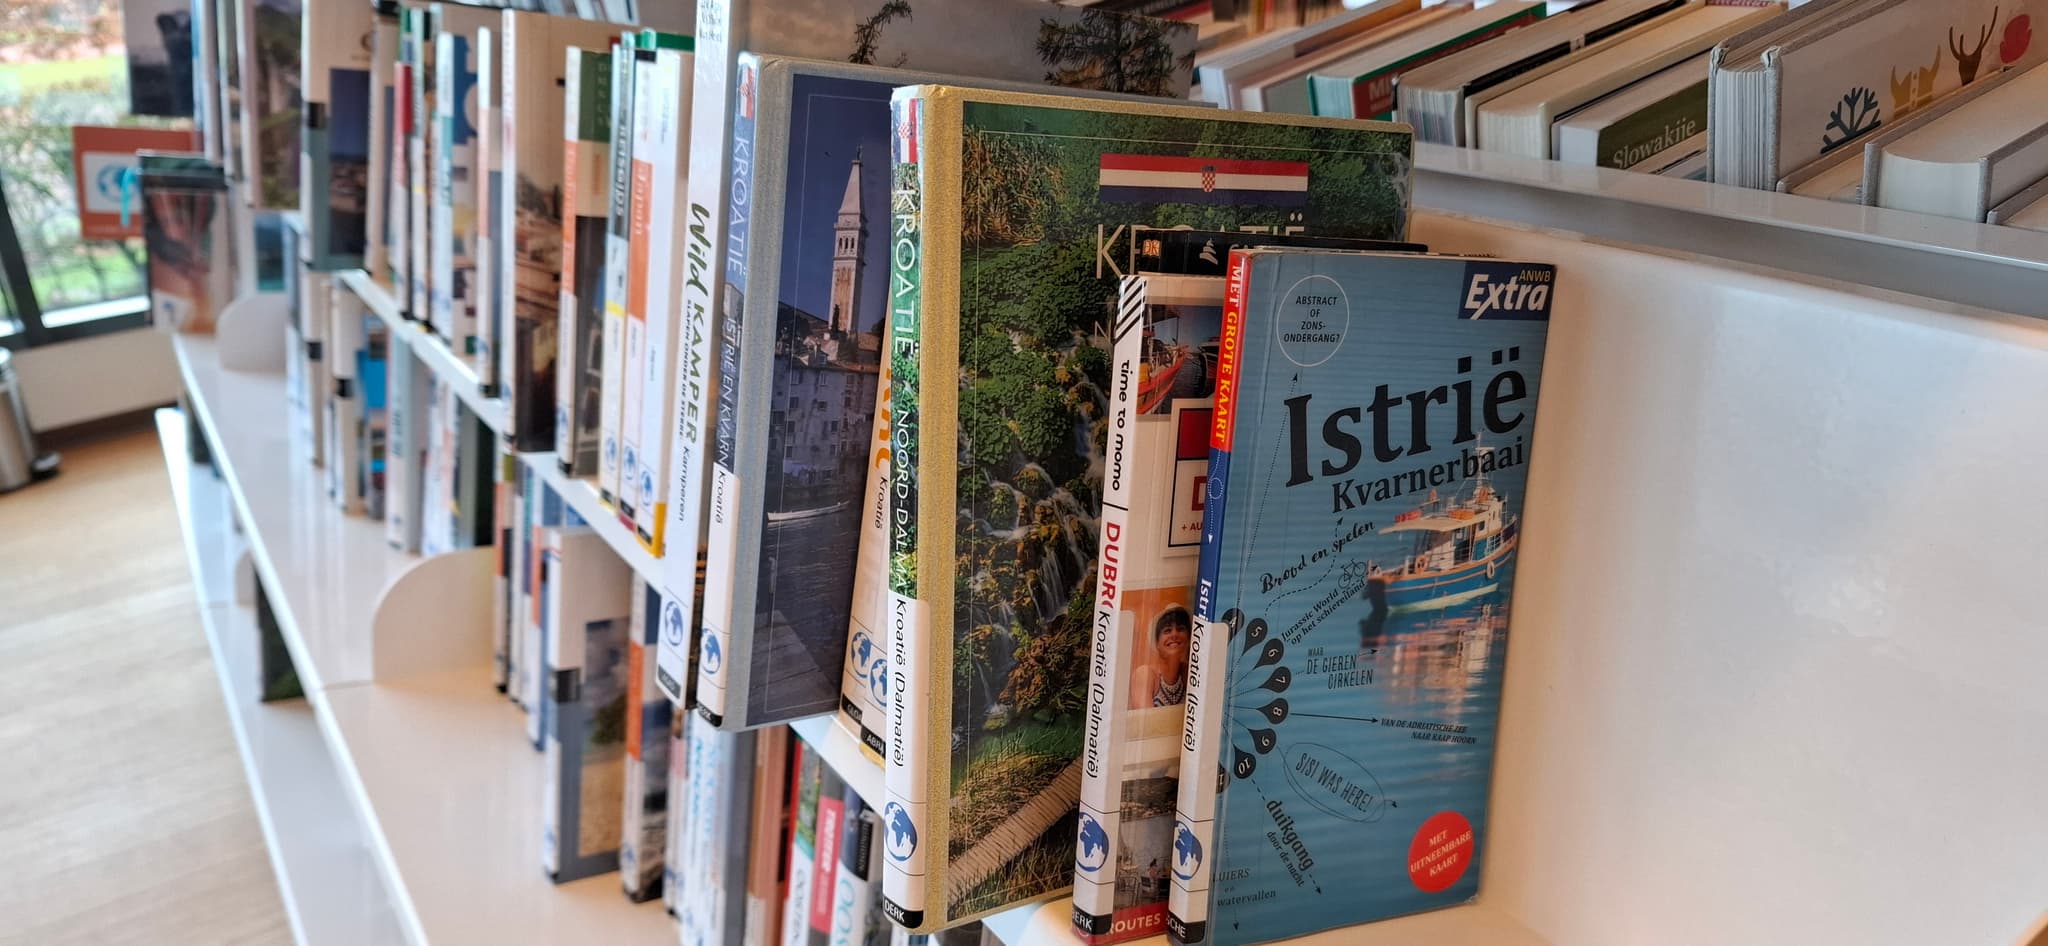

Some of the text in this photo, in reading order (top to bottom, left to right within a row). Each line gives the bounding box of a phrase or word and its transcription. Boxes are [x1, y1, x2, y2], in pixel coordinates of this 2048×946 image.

[728, 137, 750, 277] KROATIË
[894, 190, 919, 354] KROATIË
[1229, 265, 1242, 308] MET
[1519, 269, 1551, 282] ANWB
[1296, 295, 1337, 305] ABSTRACT
[1310, 308, 1320, 318] OF
[1464, 273, 1549, 320] Extra
[687, 203, 712, 444] Wild KAMPER
[722, 318, 737, 373] ISTRIË
[1222, 311, 1238, 375] GROTE
[1283, 333, 1340, 343] ONDERGANG?
[1301, 321, 1326, 330] ZONS-
[721, 375, 734, 401] EN
[1215, 378, 1232, 443] KAART
[1112, 359, 1133, 492] time to momo
[1284, 346, 1527, 488] Istrië
[679, 446, 691, 522] Kamperen
[715, 470, 726, 524] Kroatië
[1332, 436, 1524, 514] Kvarnerbaai
[875, 476, 889, 530] Kroatië
[1101, 521, 1120, 609] DUBR
[1260, 521, 1376, 595] Brood en spelen
[1251, 626, 1262, 637] 5
[1281, 588, 1339, 640] Jurassic World
[1290, 579, 1365, 645] op het schiereiland
[1268, 648, 1279, 657] 6
[1306, 654, 1357, 674] DE GIEREN
[1308, 647, 1324, 656] WAAR
[892, 598, 907, 768] Kroatië (Dalmatië)
[1086, 610, 1110, 779] Kroatië (Dalmatië)
[1184, 621, 1204, 752] Kroatië (Istrië)
[1275, 676, 1286, 684] 7
[1328, 668, 1373, 690] CIRKELEN
[1273, 706, 1282, 716] 8
[1381, 717, 1468, 734] VAN DE ADRIATISCHE ZEE
[1261, 735, 1270, 747] 9
[1411, 731, 1478, 745] NAAR KAAP HOORN
[1238, 757, 1251, 775] 10
[1296, 752, 1374, 813] SISI WAS HERE!
[1266, 800, 1314, 872] duikgang
[1410, 830, 1471, 873] UITNEEMBARE
[1429, 829, 1448, 847] MET
[1267, 831, 1305, 887] door de nacht
[1429, 852, 1458, 877] KAART
[884, 900, 905, 922] DERK
[1217, 889, 1276, 906] watervallen
